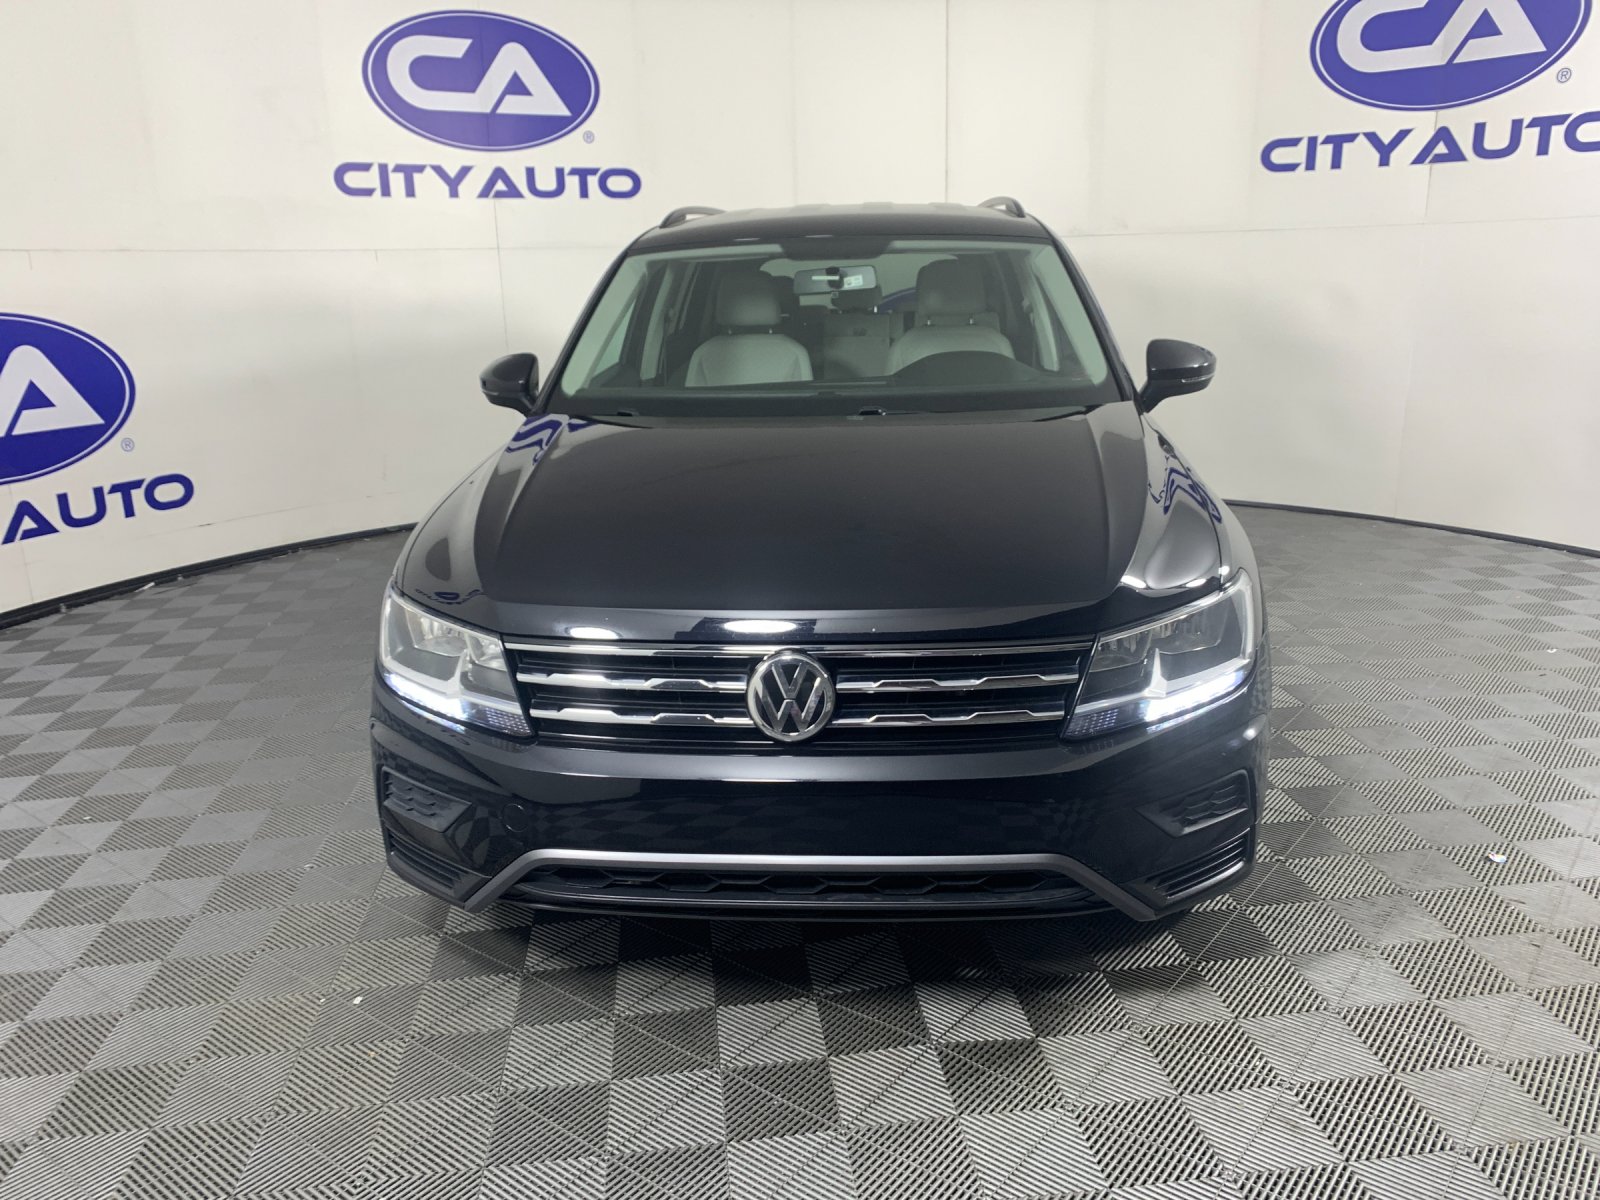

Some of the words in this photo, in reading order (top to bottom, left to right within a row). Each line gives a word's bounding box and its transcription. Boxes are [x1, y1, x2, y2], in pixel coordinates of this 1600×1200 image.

[1336, 0, 1548, 74] CA
[386, 34, 572, 117] CA
[333, 161, 475, 199] CITY
[476, 166, 642, 199] AUTO
[1260, 127, 1416, 173] CITY
[0, 344, 106, 438] A
[1, 473, 194, 545] AUTO
